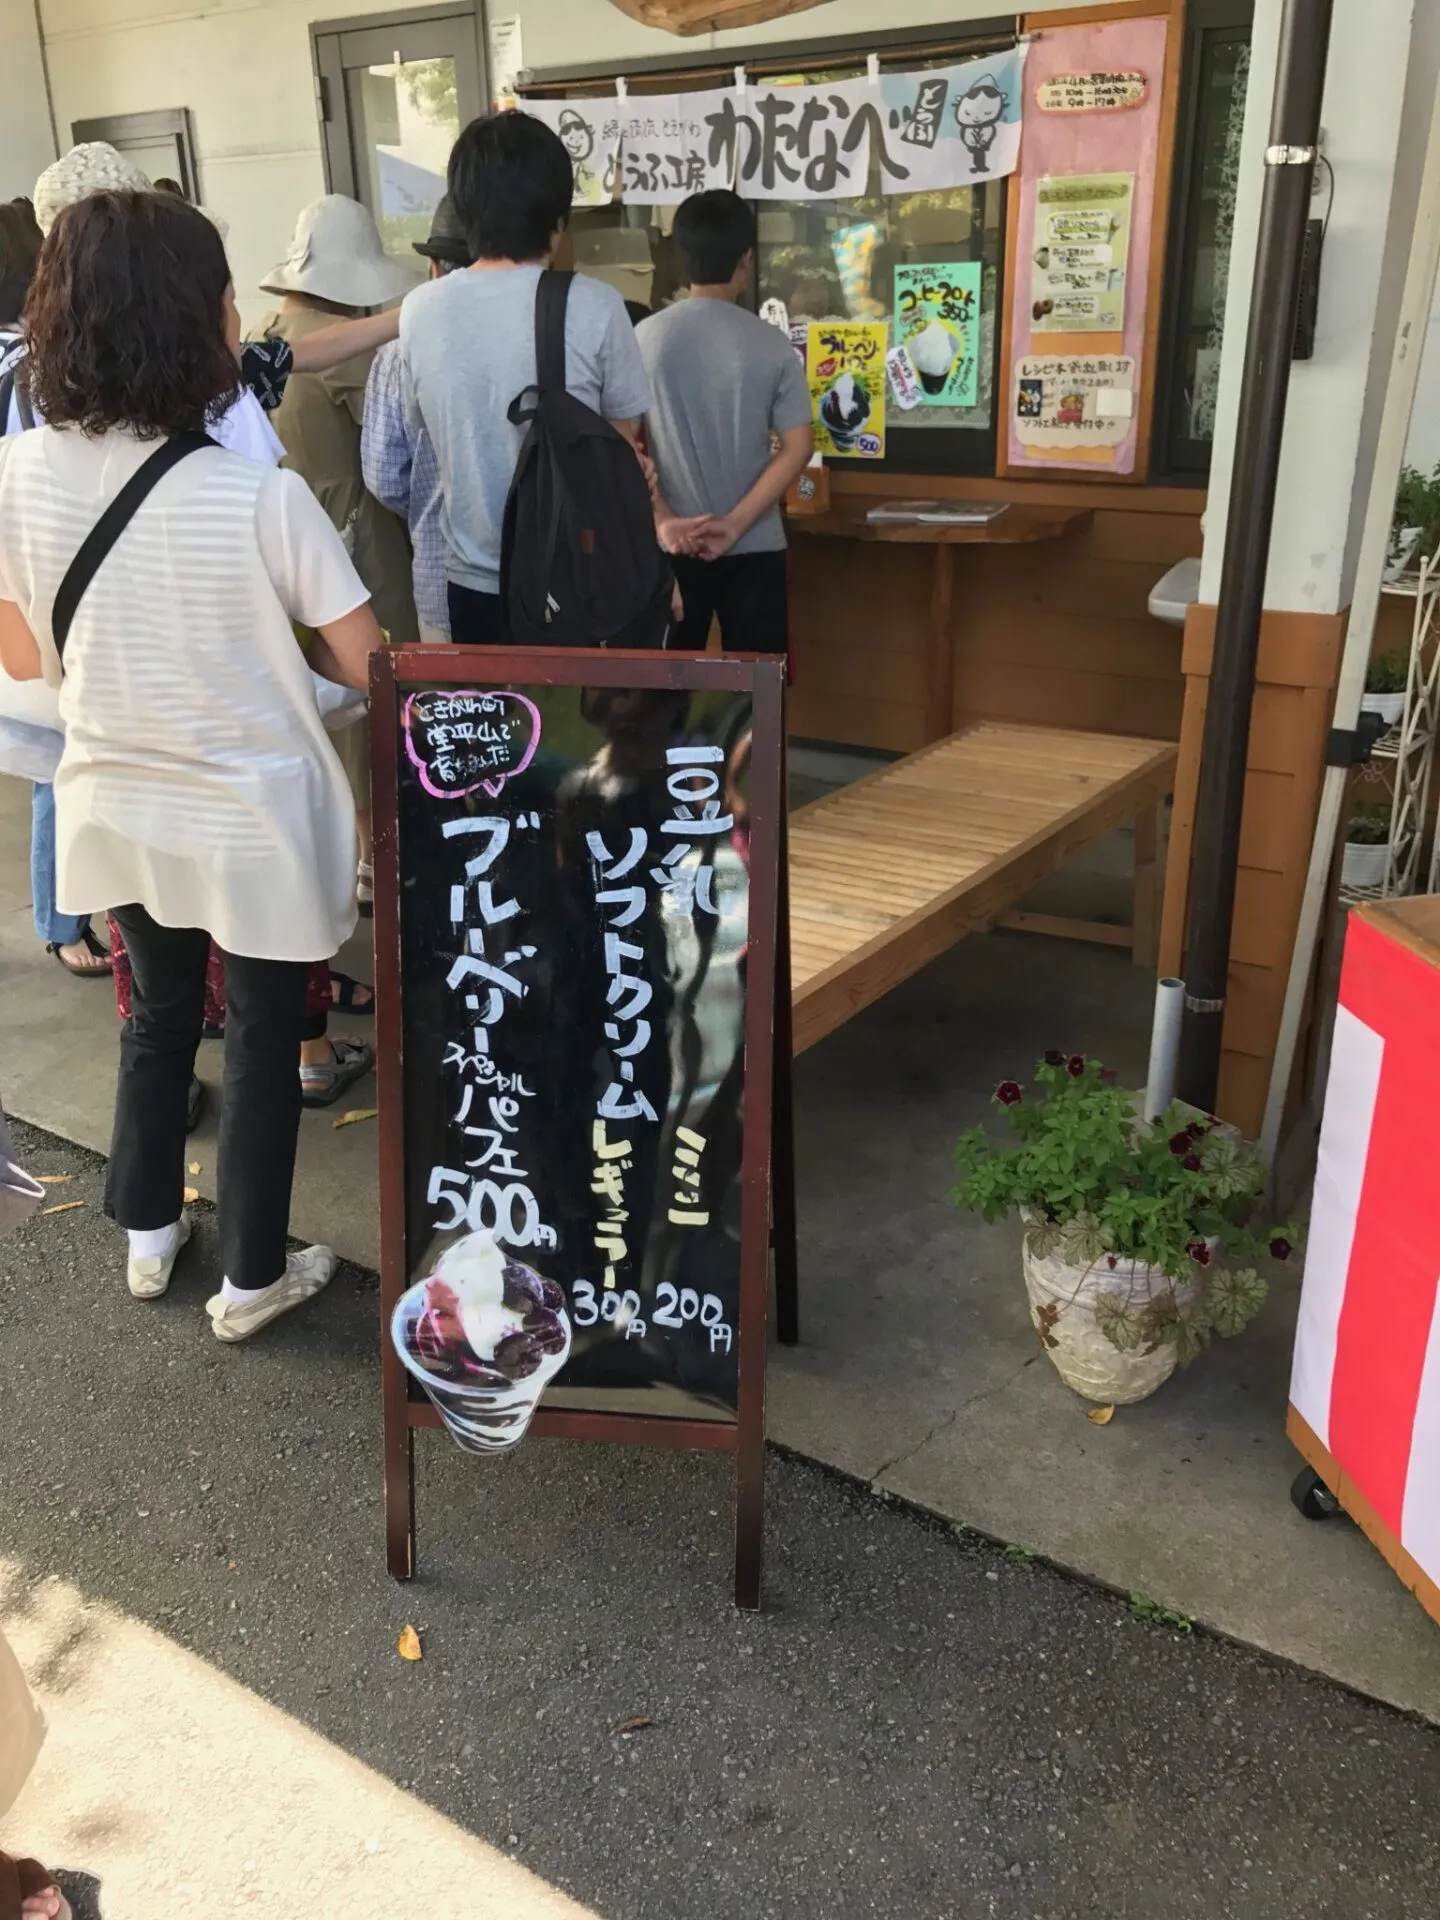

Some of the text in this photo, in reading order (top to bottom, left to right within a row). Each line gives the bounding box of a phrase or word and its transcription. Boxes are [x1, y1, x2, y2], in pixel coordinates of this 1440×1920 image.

[704, 93, 911, 192] わたなべ
[908, 84, 943, 143] とうふ
[603, 149, 706, 194] とうふ工房
[937, 301, 974, 323] 350
[442, 811, 541, 1053] ブルーベリー
[585, 827, 659, 1122] ソフトクリーム
[450, 1084, 529, 1176] パフェ
[426, 1165, 558, 1248] 500円
[572, 1279, 646, 1341] 300円
[652, 1280, 732, 1355] 200円
